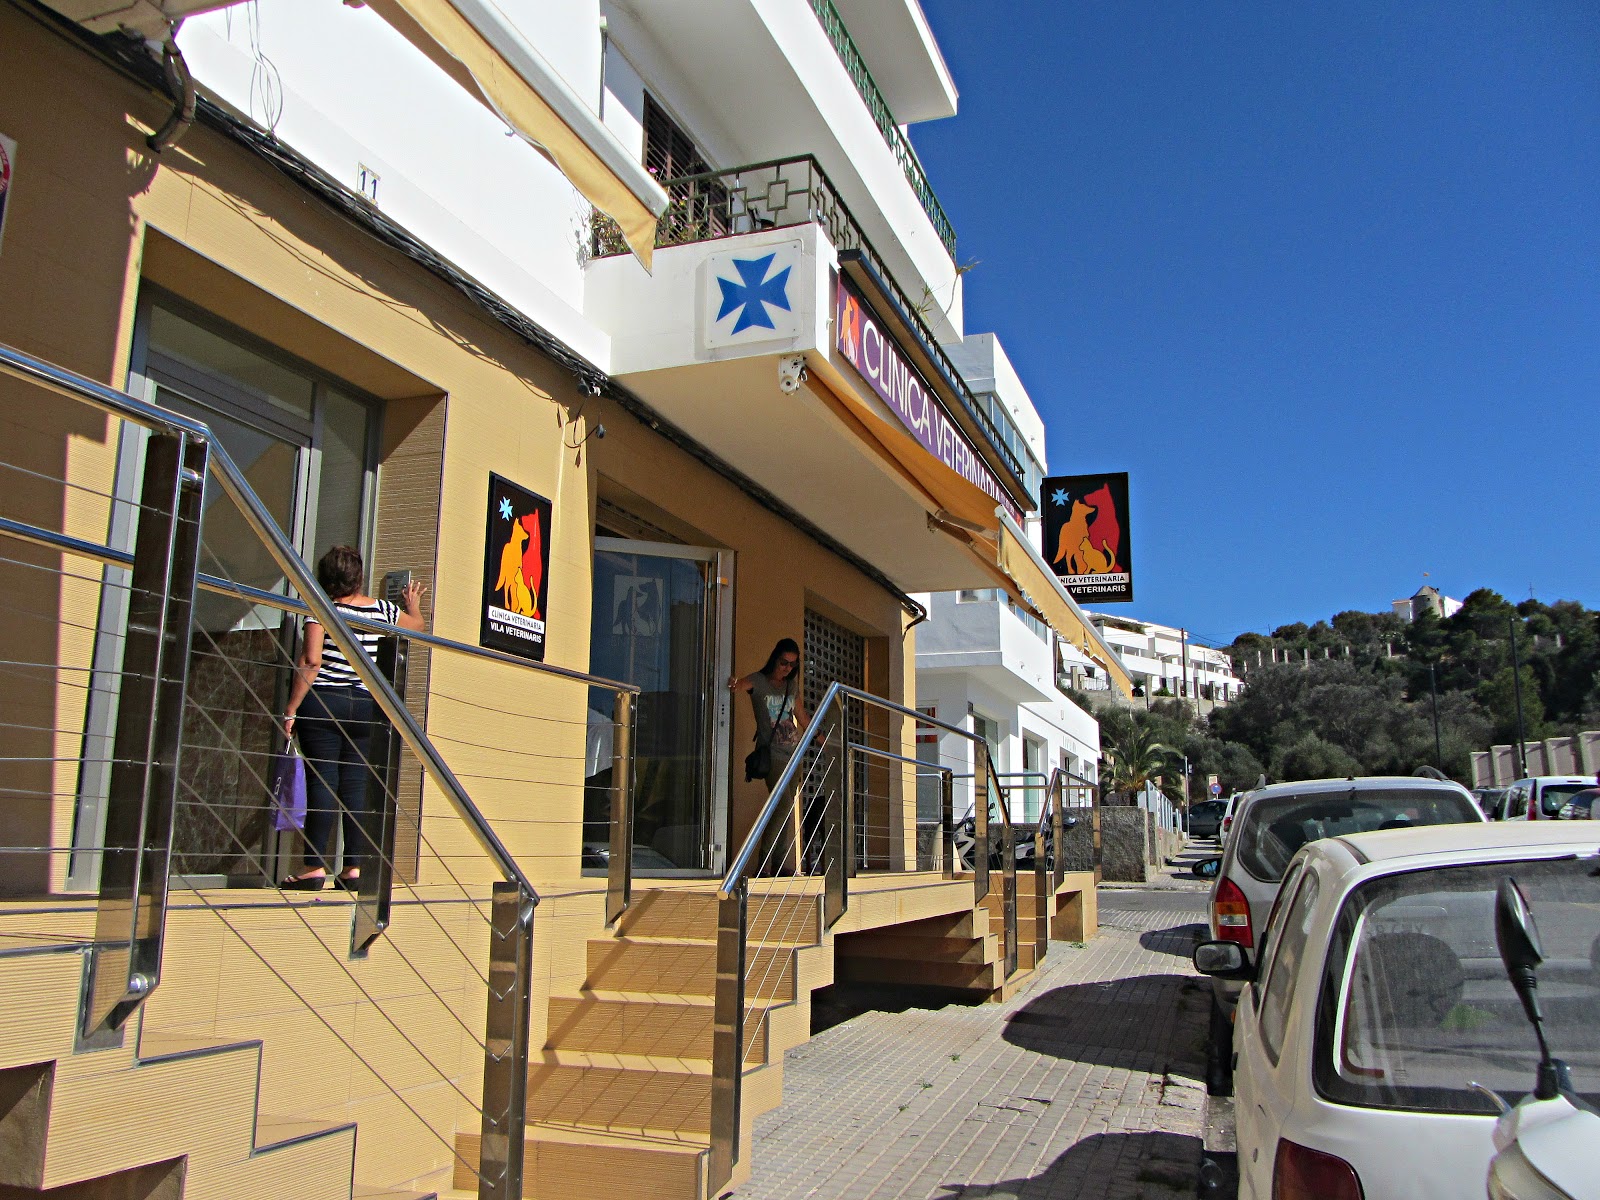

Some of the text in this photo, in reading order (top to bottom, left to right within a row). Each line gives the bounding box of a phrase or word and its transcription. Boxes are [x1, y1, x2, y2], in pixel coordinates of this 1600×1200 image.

[360, 170, 377, 200] 11
[1078, 575, 1125, 584] VETERINARIA
[1071, 585, 1126, 594] VETERINARIS
[511, 615, 542, 631] VETERINARIA
[490, 621, 542, 643] VILA VETERINARIS
